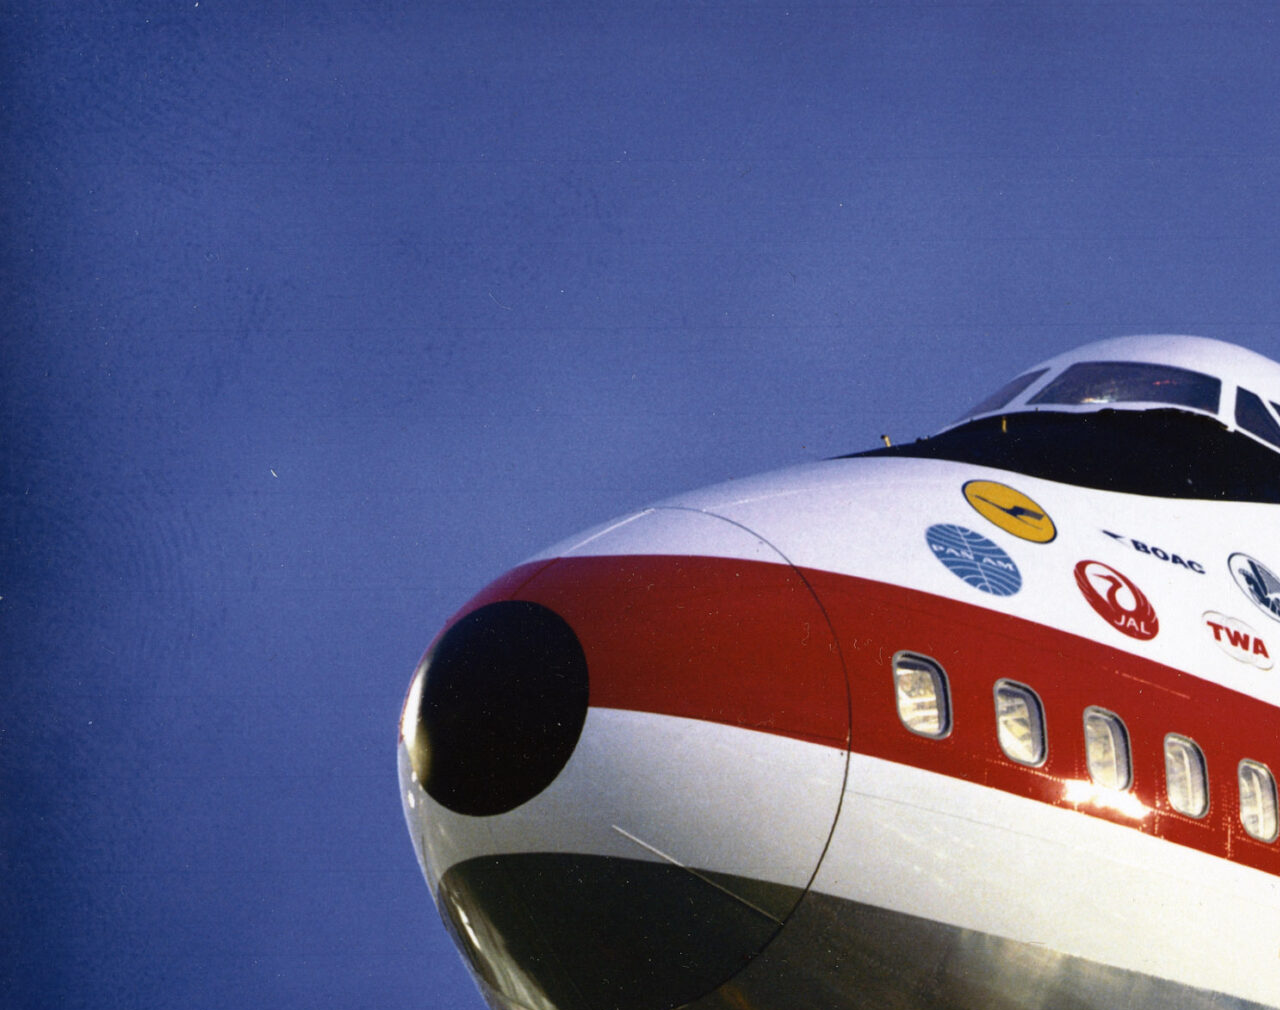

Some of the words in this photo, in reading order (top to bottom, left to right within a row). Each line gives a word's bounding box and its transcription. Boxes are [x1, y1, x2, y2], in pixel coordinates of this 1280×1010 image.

[931, 543, 974, 560] PAN
[982, 556, 1014, 571] AM
[1131, 539, 1205, 574] BOAC
[1114, 615, 1151, 635] JAL
[1206, 620, 1270, 659] TWA
